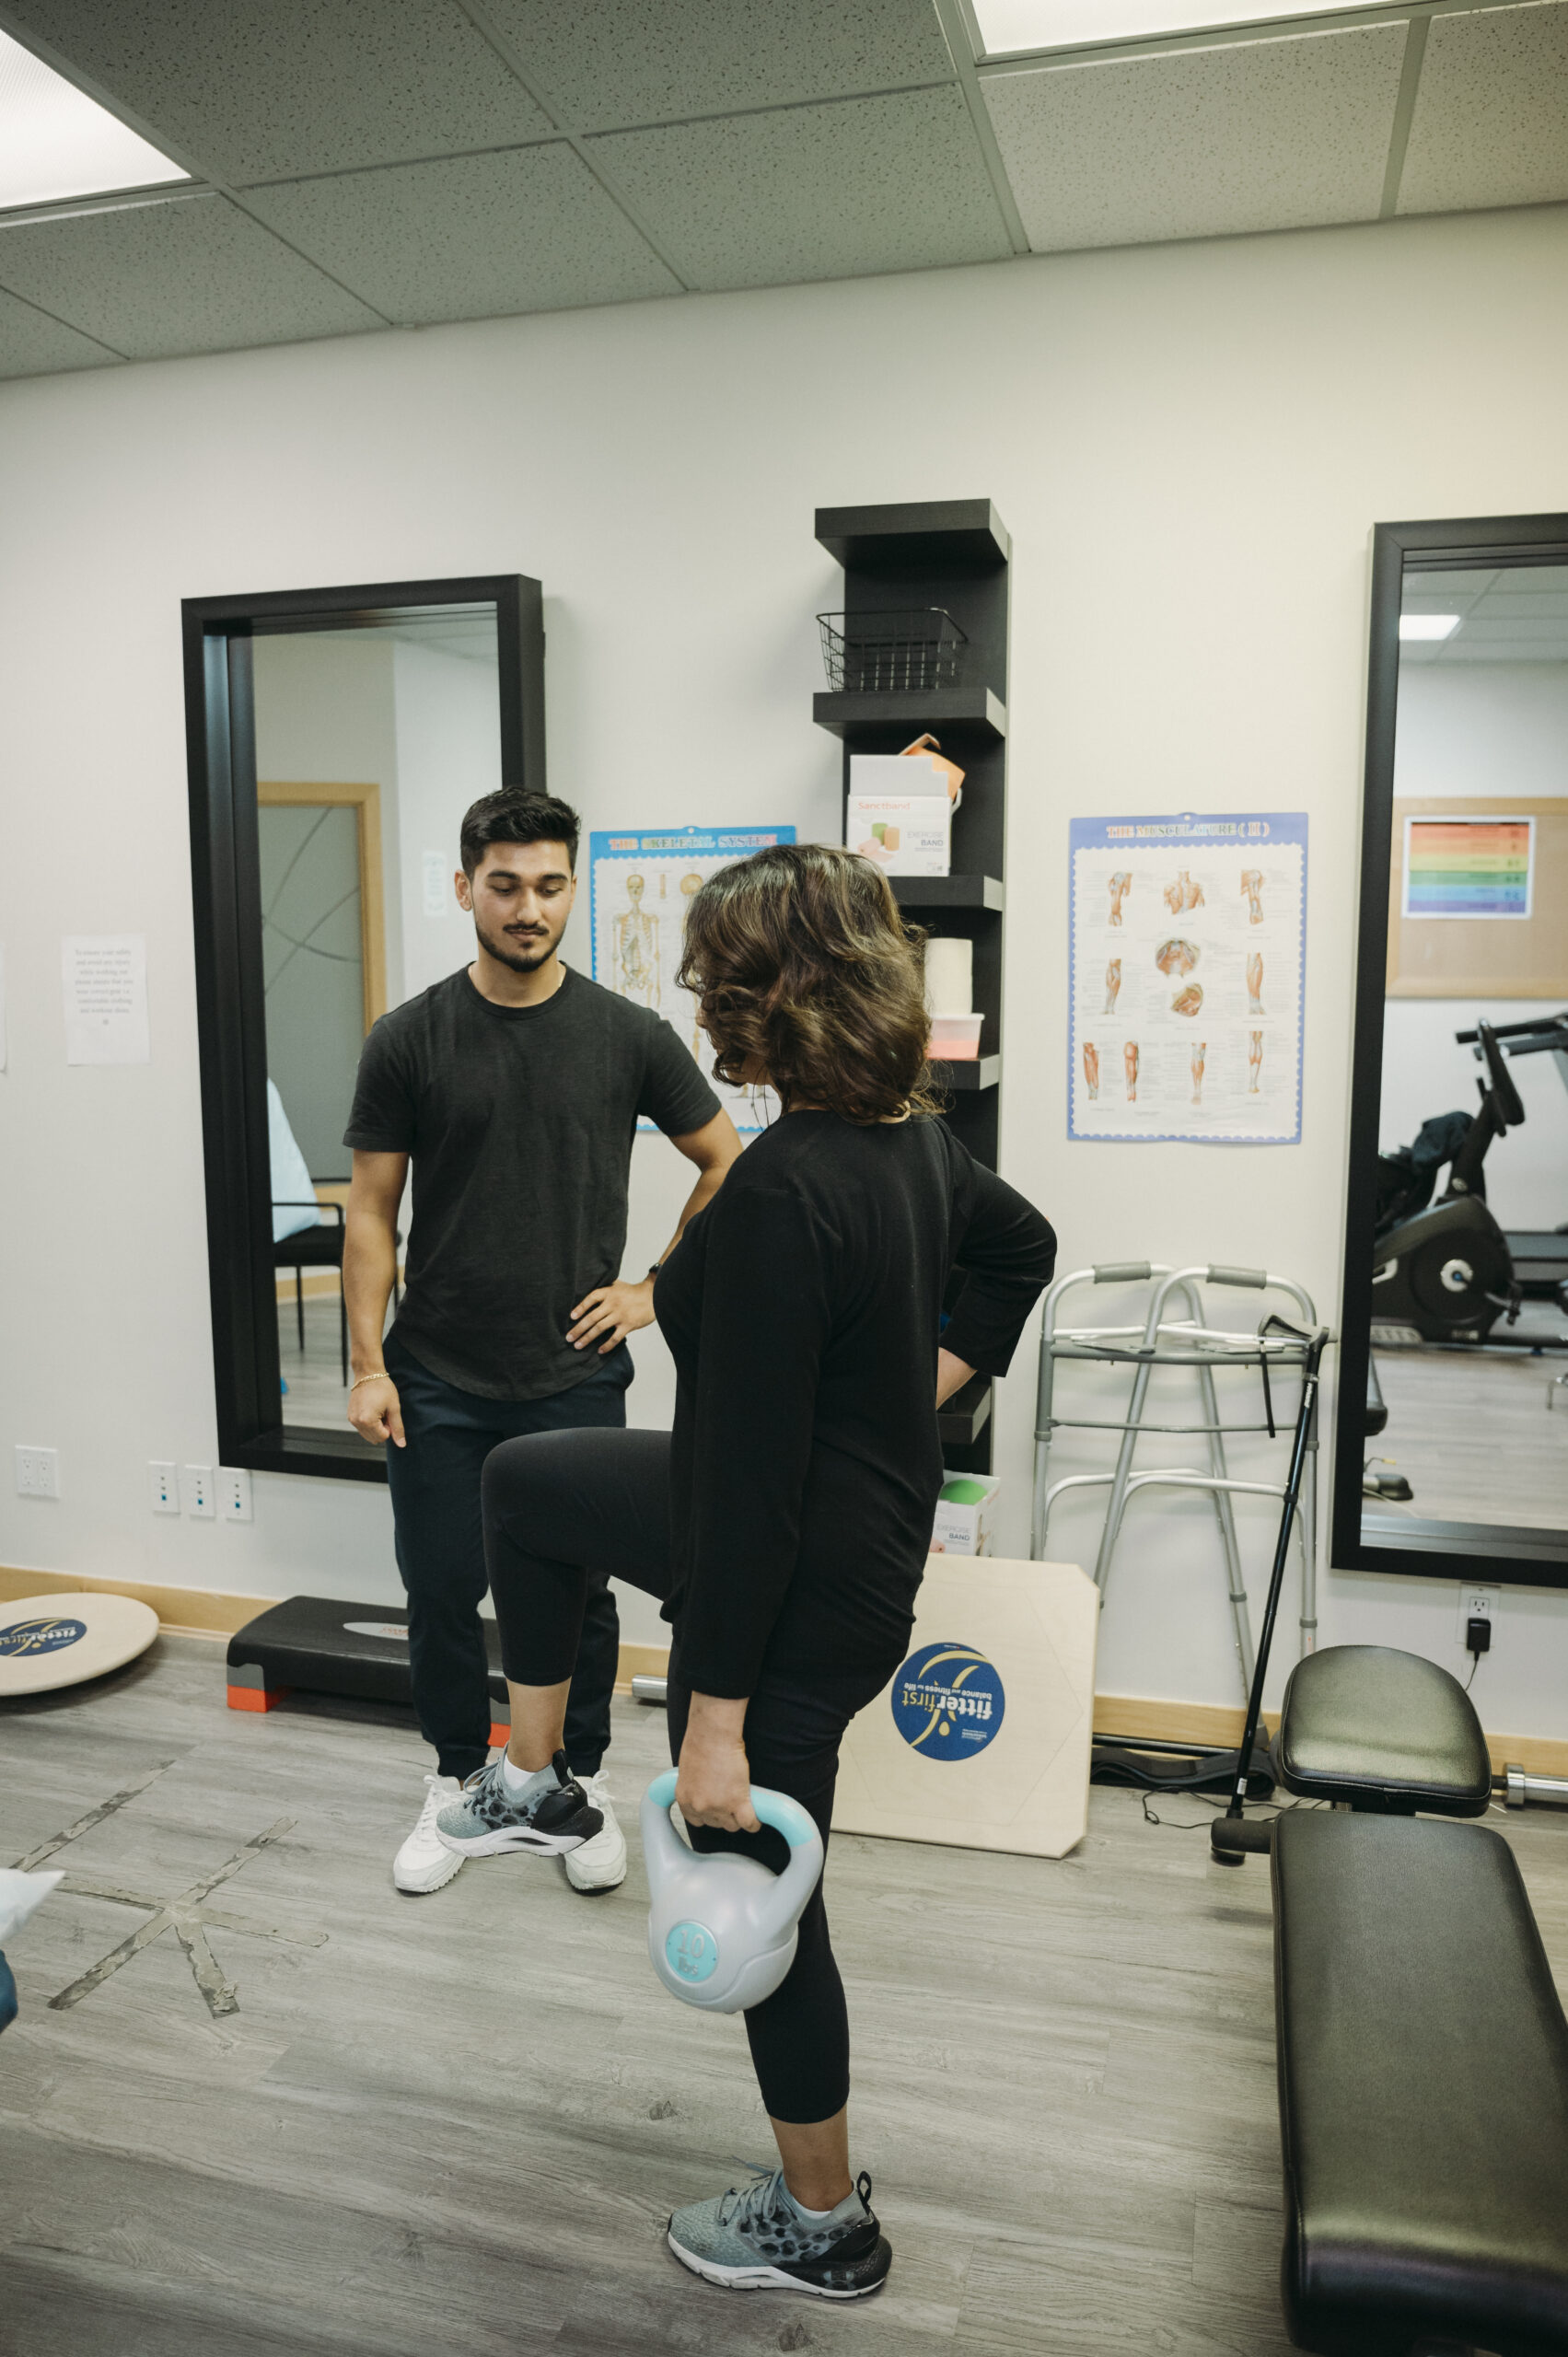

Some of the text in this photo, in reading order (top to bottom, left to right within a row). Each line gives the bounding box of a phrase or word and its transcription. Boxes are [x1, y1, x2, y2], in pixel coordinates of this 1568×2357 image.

[857, 802, 911, 810] Sanctband
[1107, 825, 1134, 839] THE
[1135, 823, 1237, 839] MUSCULATURE
[609, 833, 777, 850] THE SKELETAL SYSTEM
[949, 1533, 970, 1541] BAND
[904, 1682, 916, 1692] life
[924, 1685, 951, 1696] fitness
[961, 1689, 993, 1701] balance
[677, 1929, 704, 1958] 10
[678, 1956, 699, 1977] lbs
